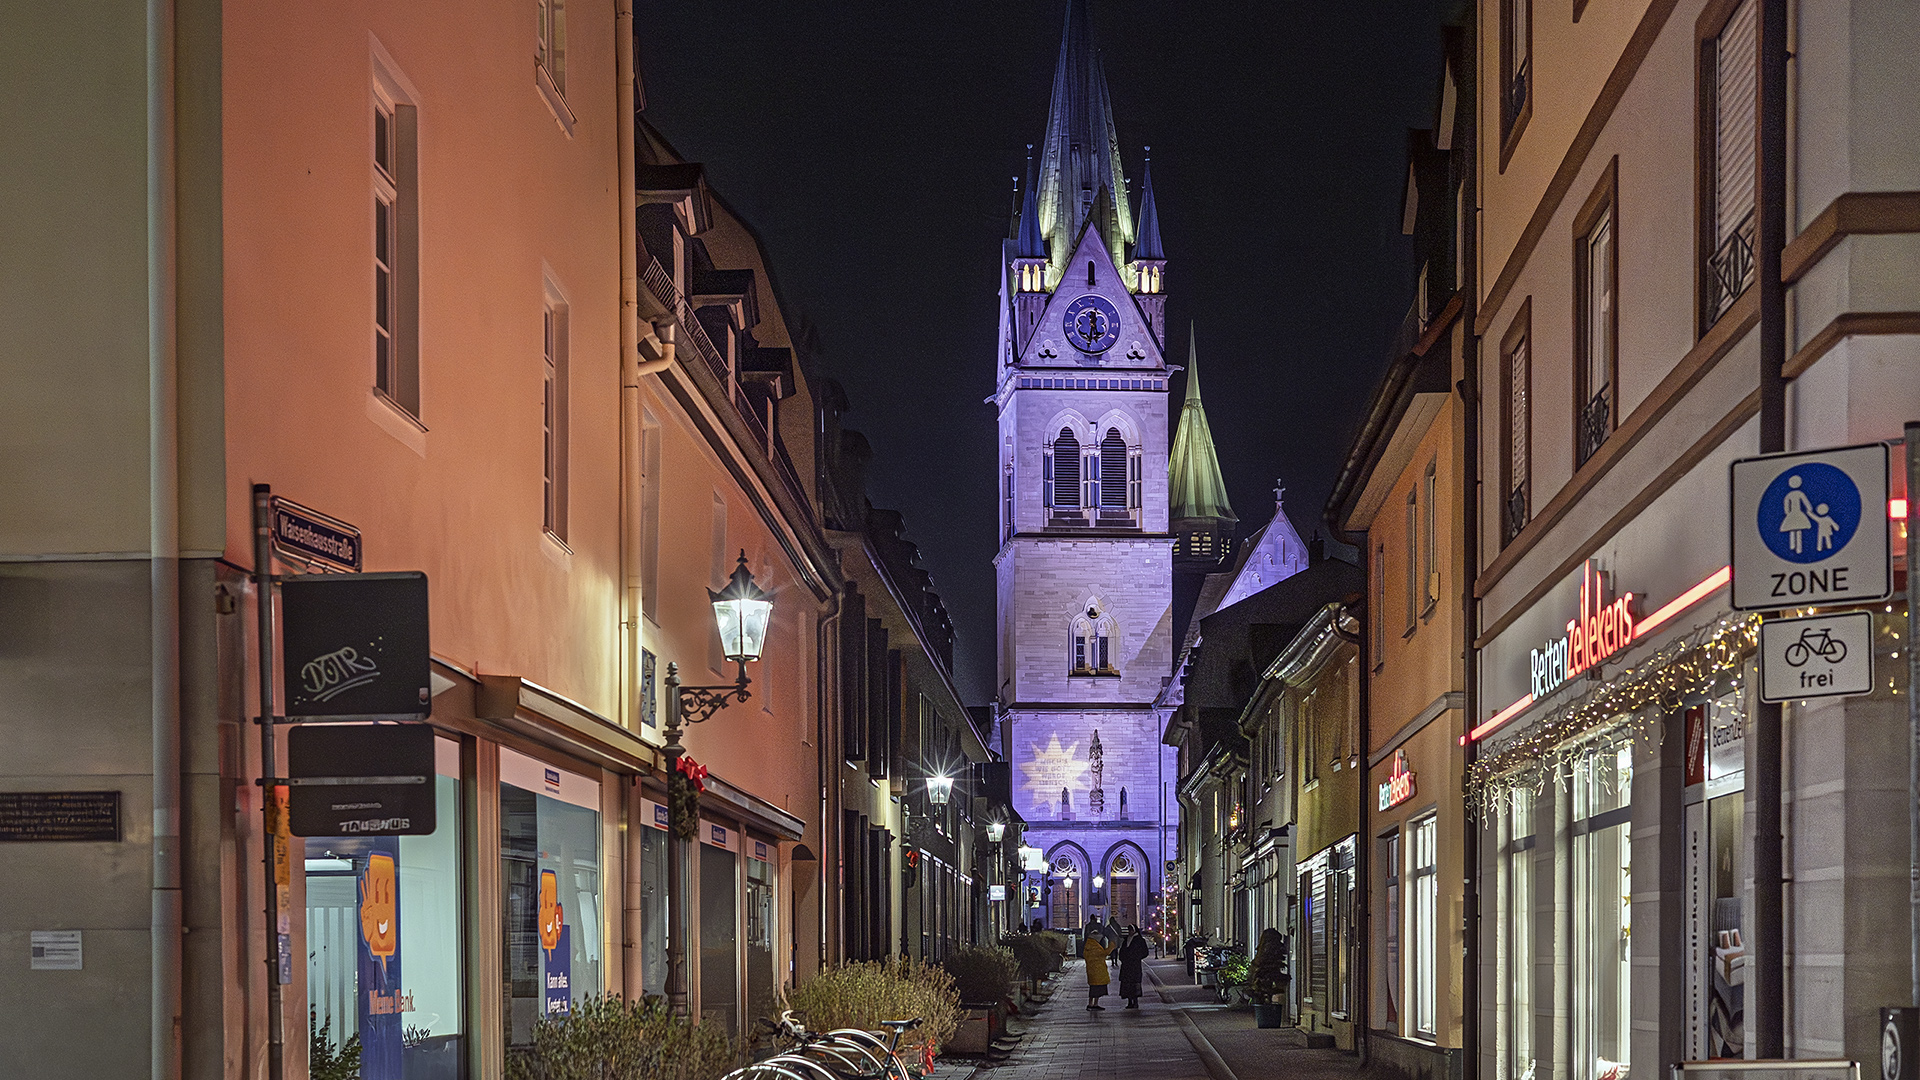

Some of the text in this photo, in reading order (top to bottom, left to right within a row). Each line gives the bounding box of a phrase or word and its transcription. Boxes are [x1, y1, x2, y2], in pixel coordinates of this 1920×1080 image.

[280, 513, 354, 561] Waisenhausstraße
[1771, 567, 1849, 597] ZONE
[1530, 558, 1633, 702] BettenZellekens
[1800, 668, 1833, 688] frei
[1713, 718, 1743, 748] BettenZe
[369, 989, 416, 1015] Meine Bank.
